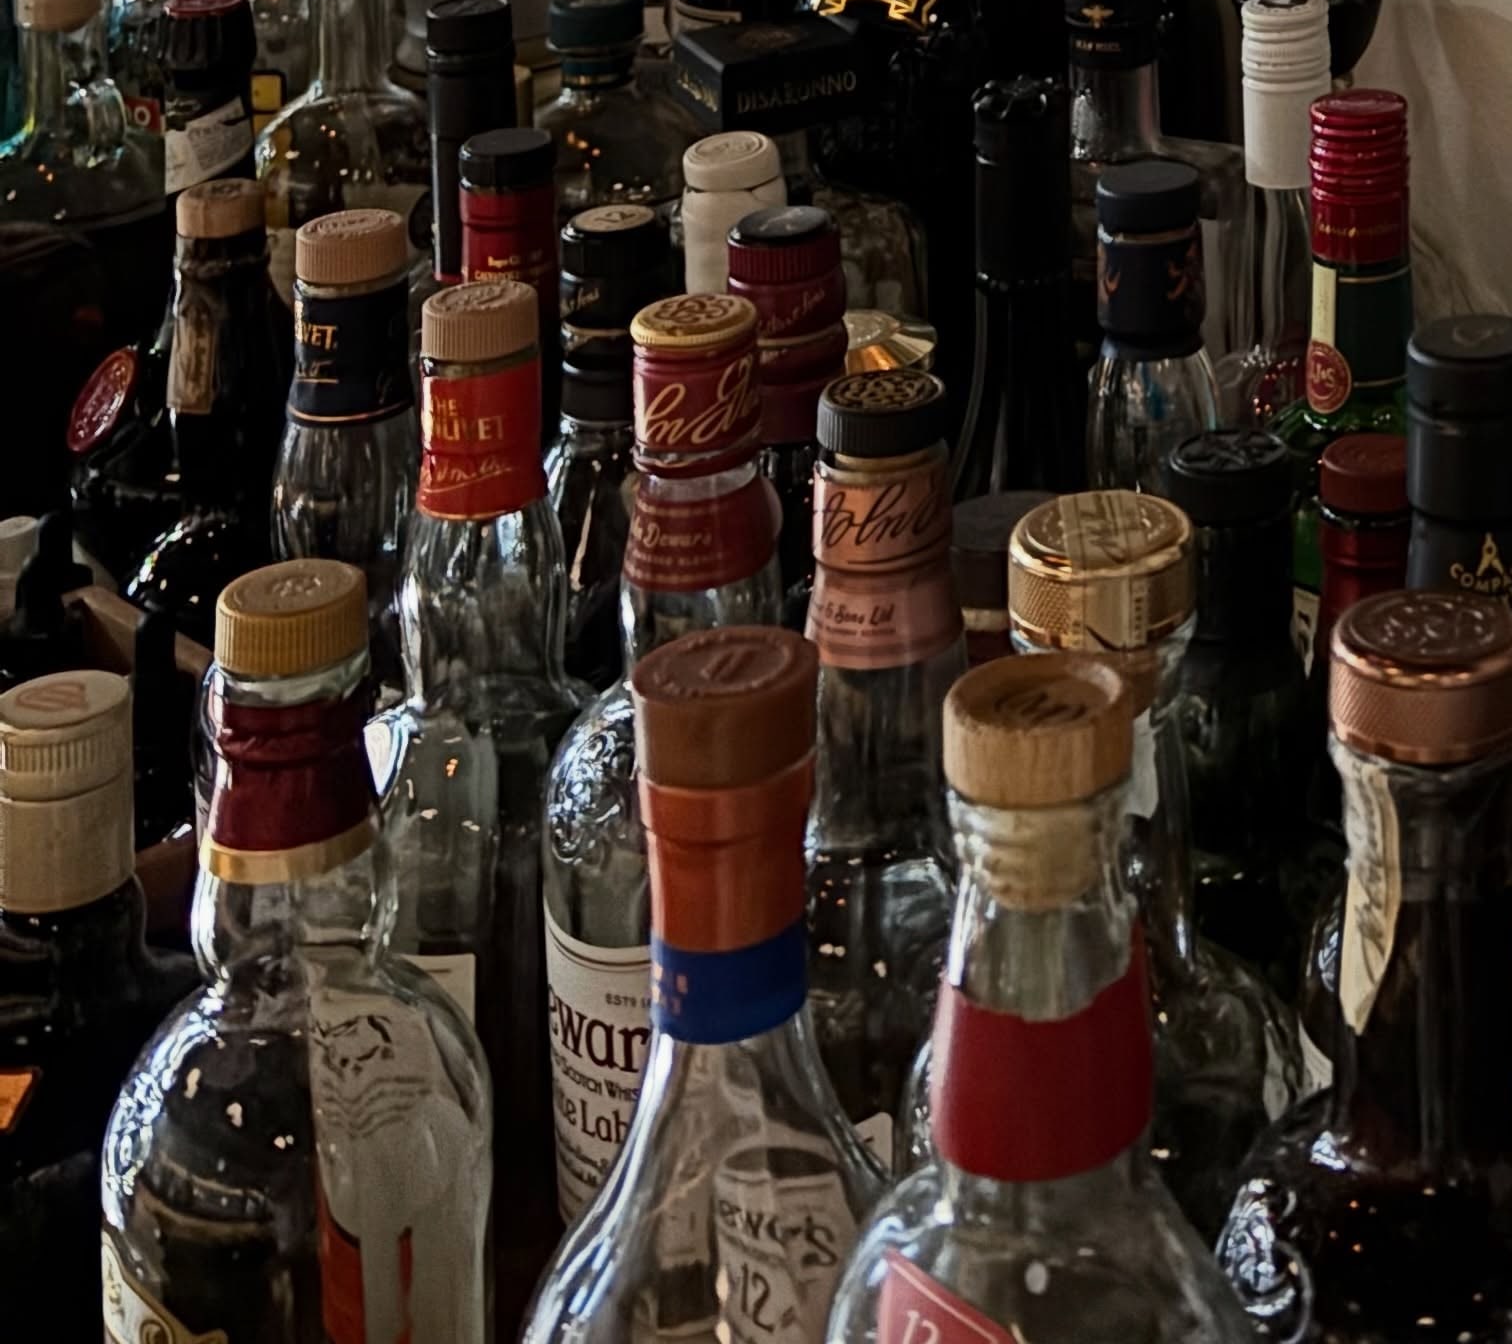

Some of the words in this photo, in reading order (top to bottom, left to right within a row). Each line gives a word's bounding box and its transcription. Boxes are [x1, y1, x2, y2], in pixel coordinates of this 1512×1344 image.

[736, 69, 857, 114] DISARONNO
[548, 982, 653, 1074] ewar
[580, 1098, 632, 1146] Lab
